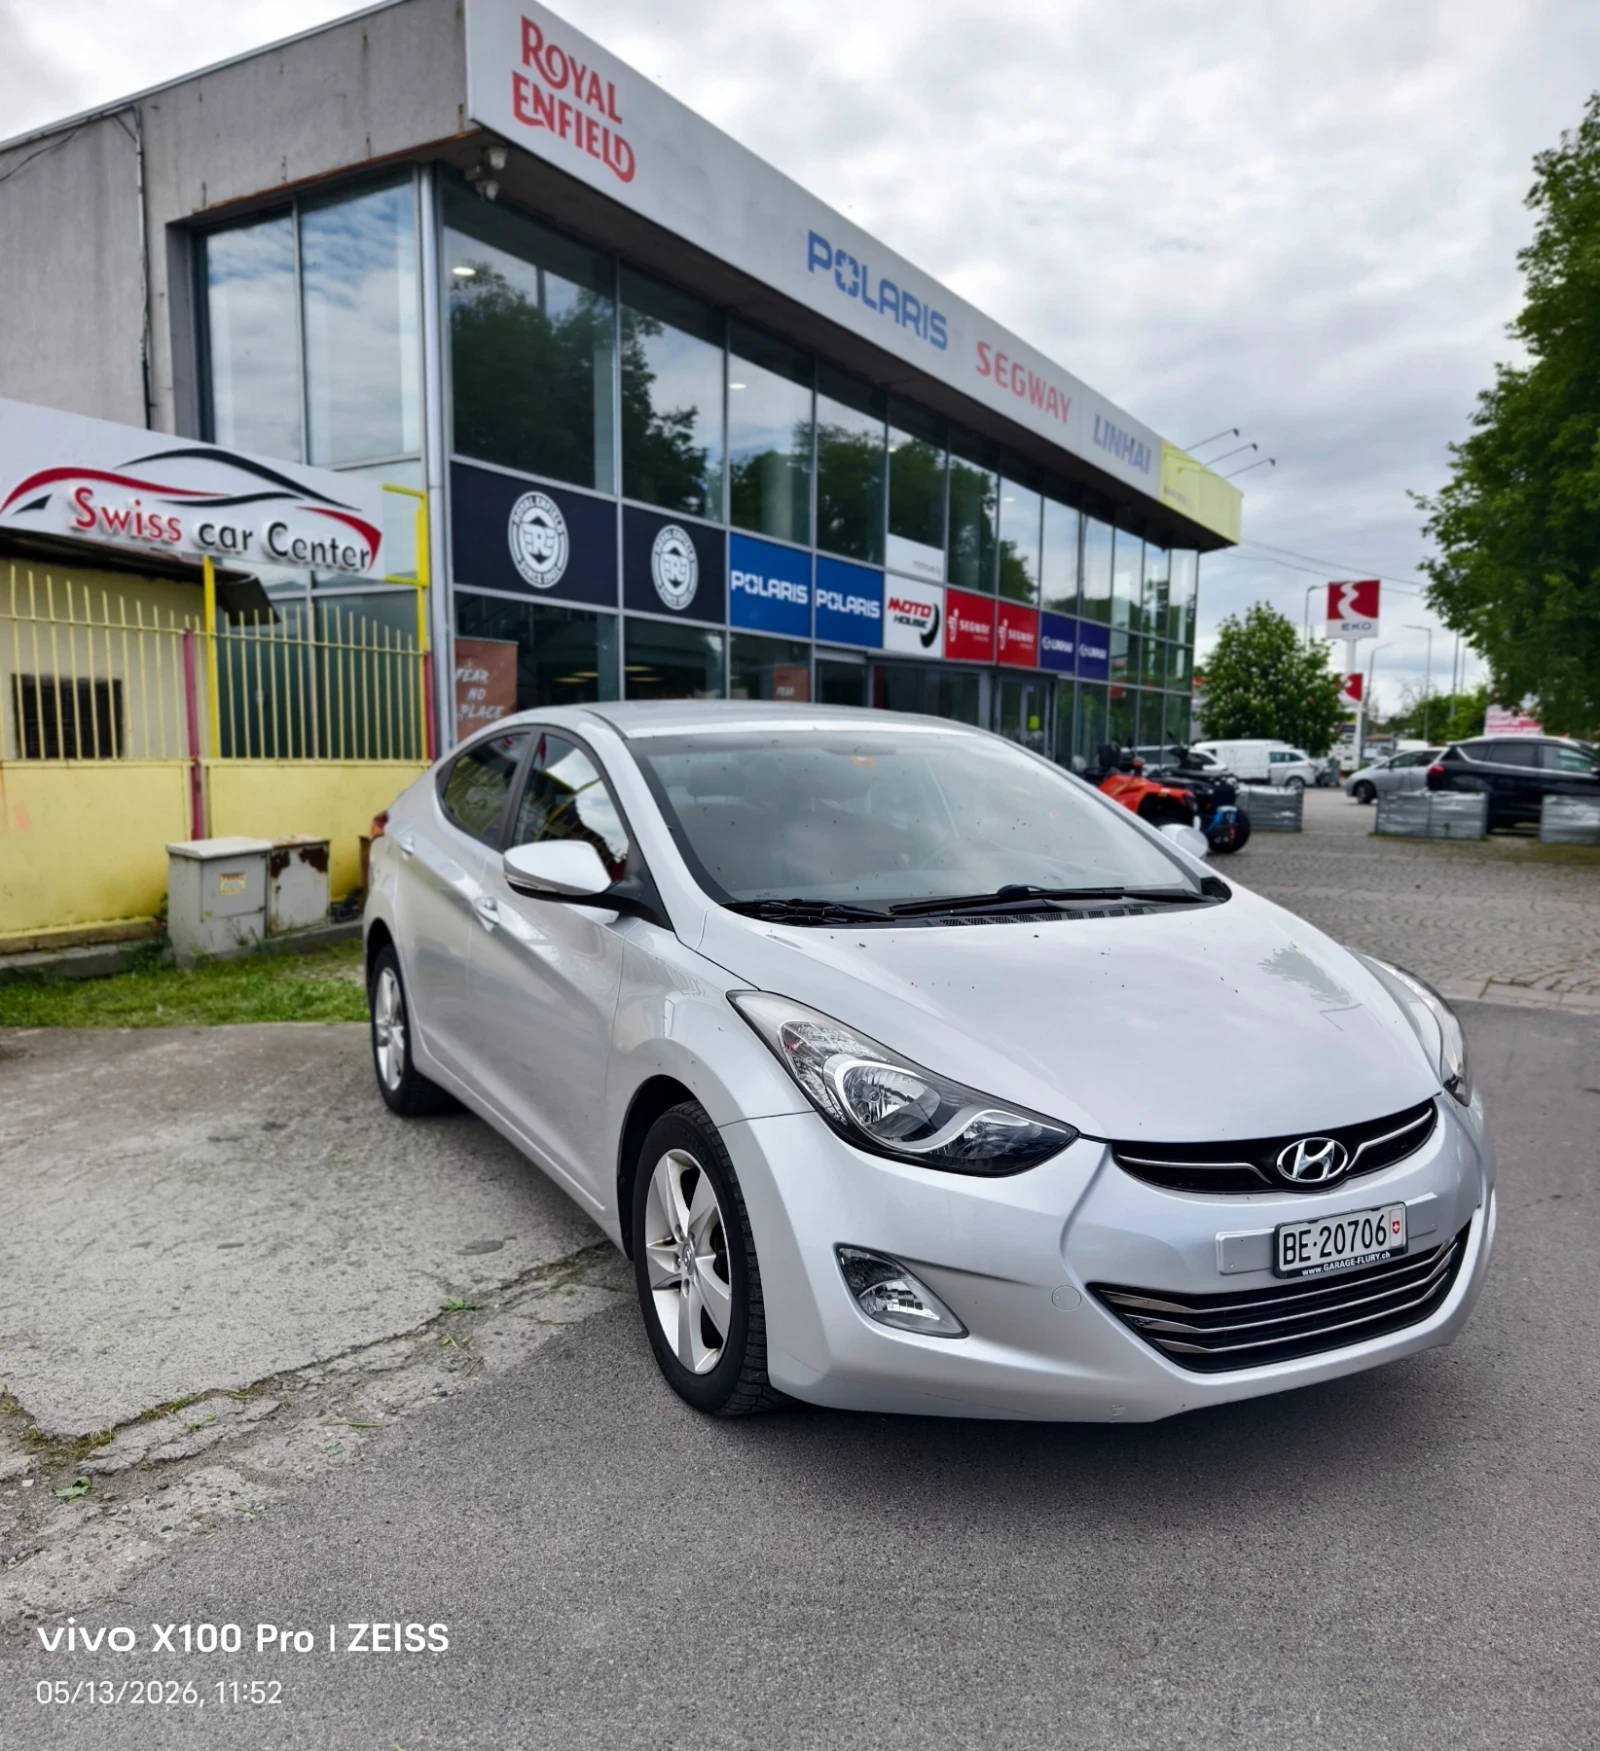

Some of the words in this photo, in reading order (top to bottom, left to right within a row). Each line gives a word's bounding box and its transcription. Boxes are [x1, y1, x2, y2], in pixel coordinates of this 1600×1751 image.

[520, 14, 623, 125] ROYAL
[511, 69, 635, 184] ENFIELD
[807, 229, 947, 351] POLARIS
[975, 340, 1071, 424] SEGWAY
[1093, 414, 1150, 474] LINHAI
[72, 486, 182, 543] Swiss
[198, 522, 254, 552] car
[266, 521, 370, 569] Center
[731, 570, 808, 604] POLARIS
[816, 589, 880, 619] POLARIS
[888, 596, 932, 618] MOTO
[893, 614, 929, 629] HOUSE
[959, 618, 991, 635] SEGWAY
[1341, 621, 1372, 631] EKO
[1008, 628, 1035, 643] SEGWAY
[467, 687, 487, 701] NO
[460, 704, 505, 719] PLACE
[1302, 1251, 1391, 1276] www.GARAGE-FLURY.ch
